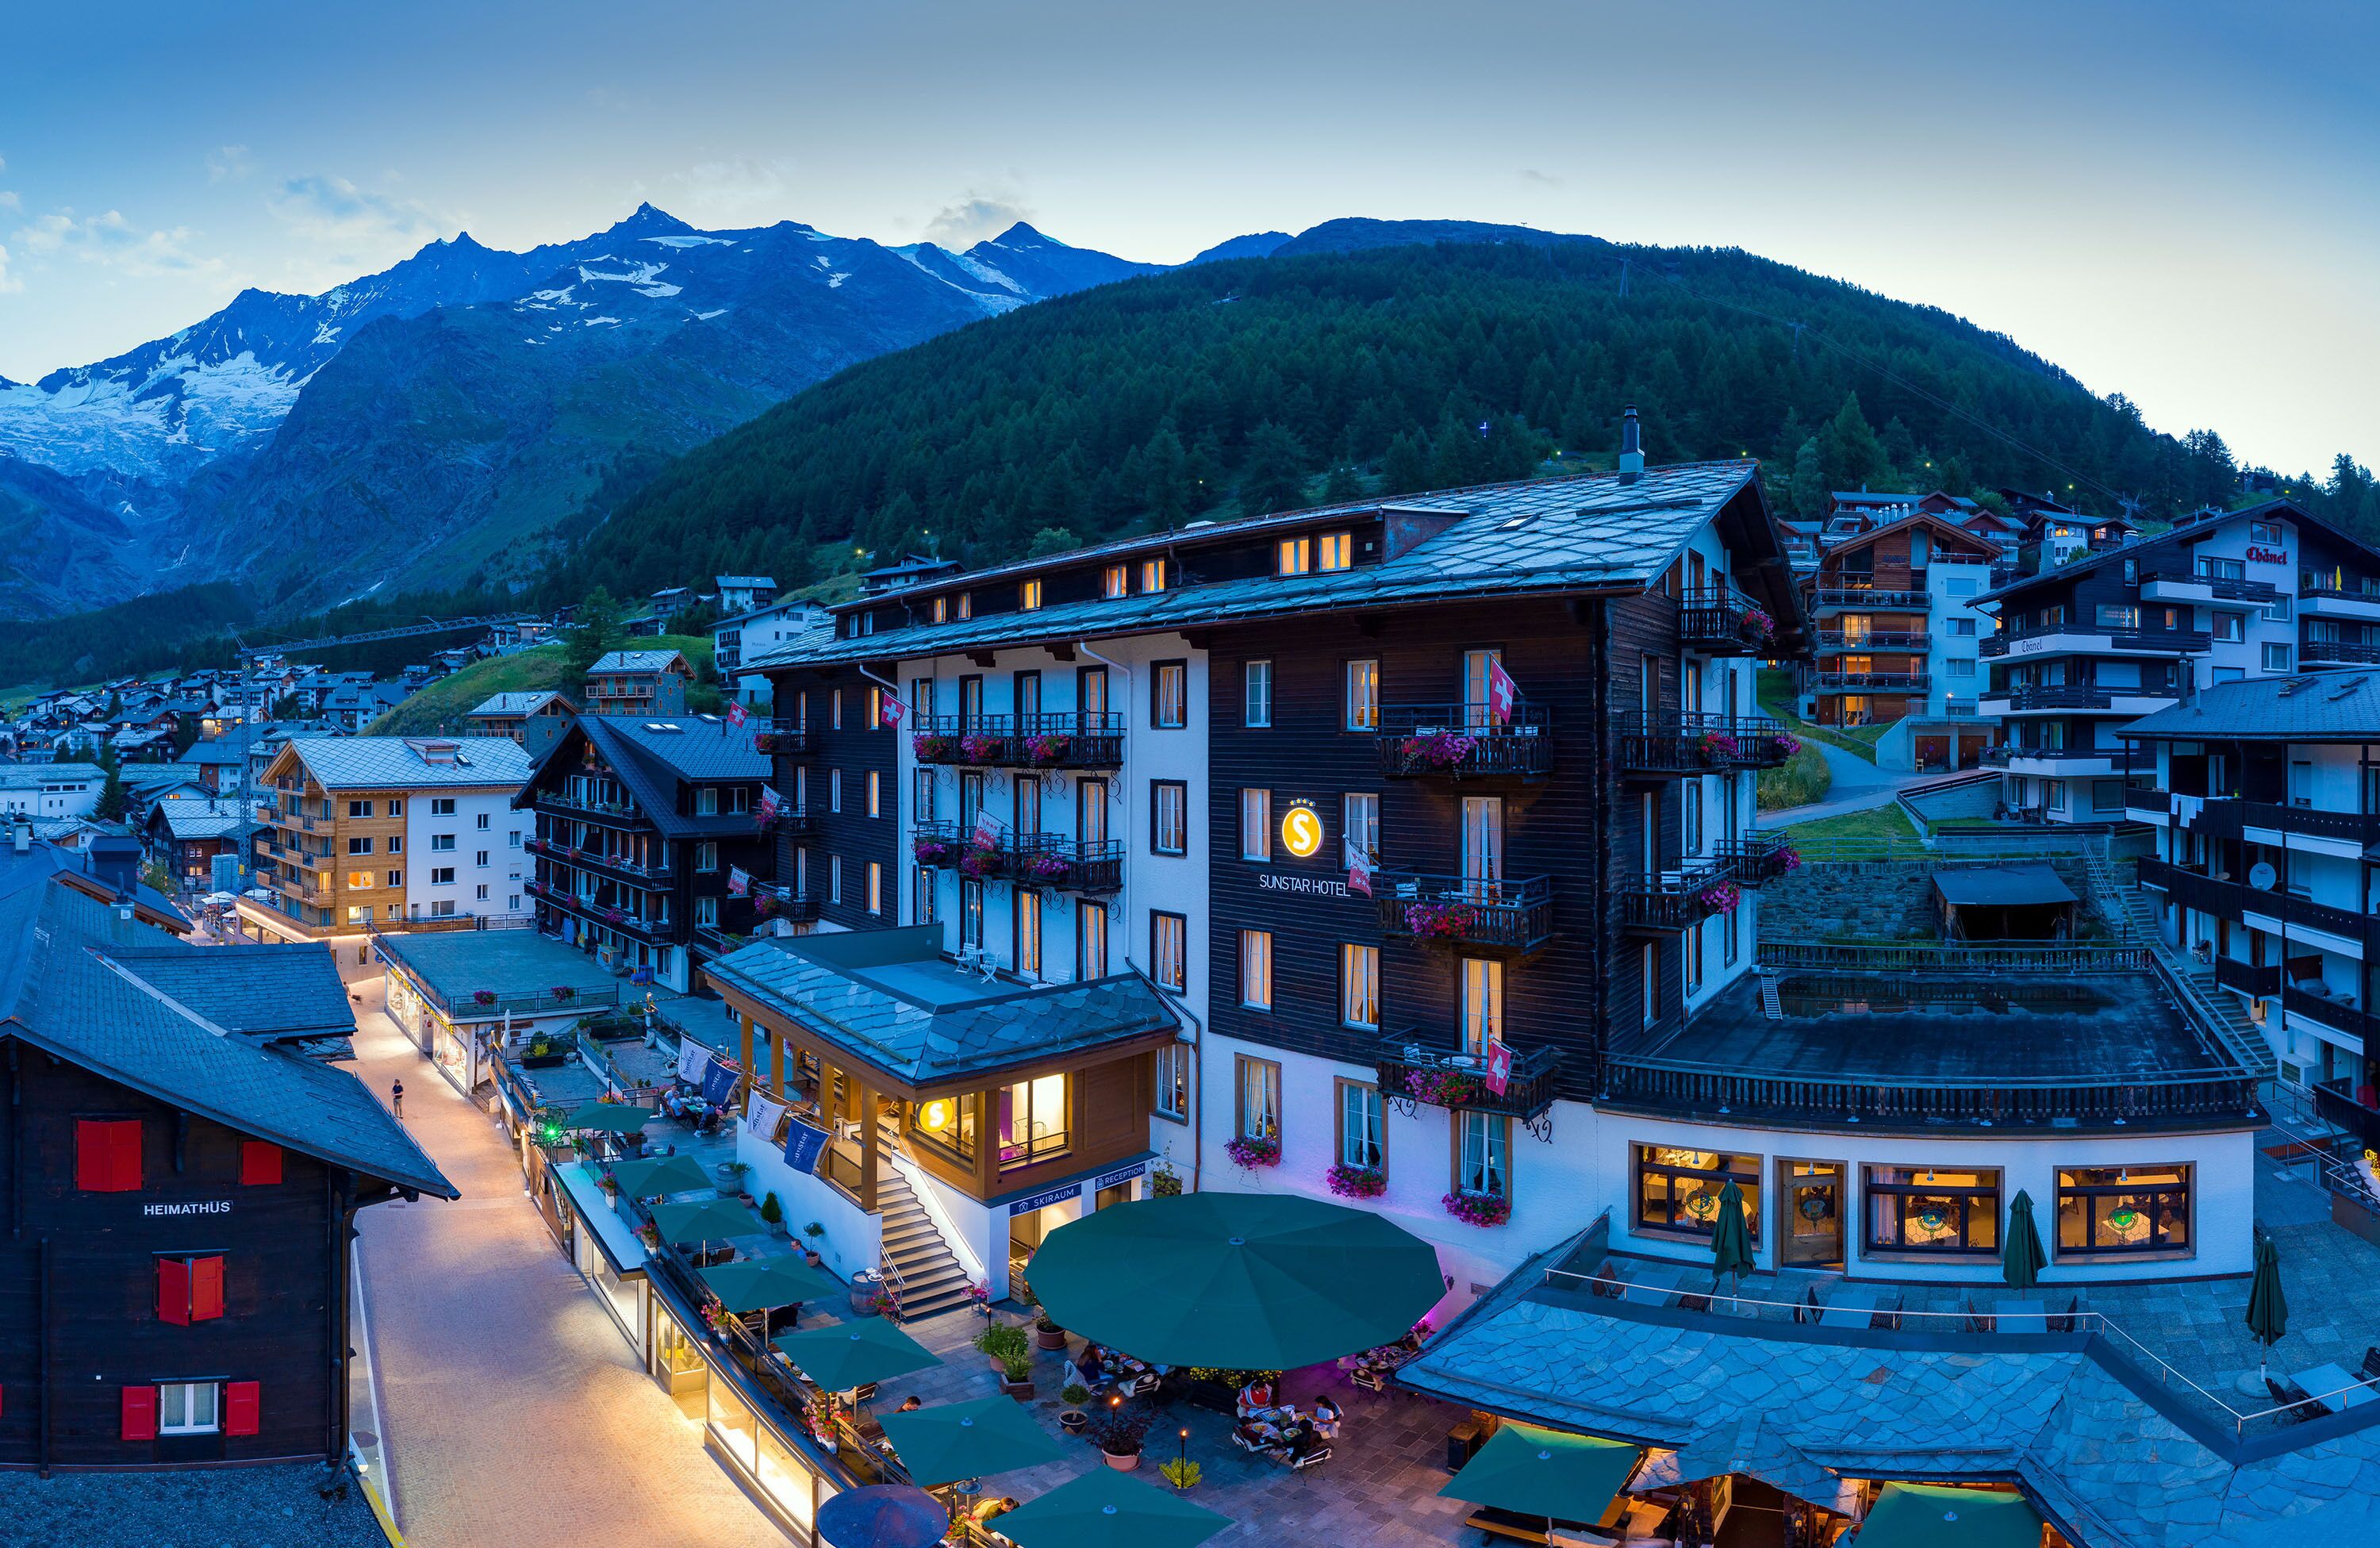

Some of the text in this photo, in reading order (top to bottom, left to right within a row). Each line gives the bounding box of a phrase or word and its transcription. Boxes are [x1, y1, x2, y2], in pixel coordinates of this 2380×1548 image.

[1292, 813, 1311, 851] S
[1259, 874, 1351, 897] SUNSTAR HOTEL
[683, 1050, 696, 1075] Sunstar
[929, 1102, 945, 1127] S
[1104, 1165, 1145, 1185] RECEPTION
[144, 1201, 230, 1216] HEIMATHÜS
[1034, 1189, 1074, 1207] SKIRAUM
